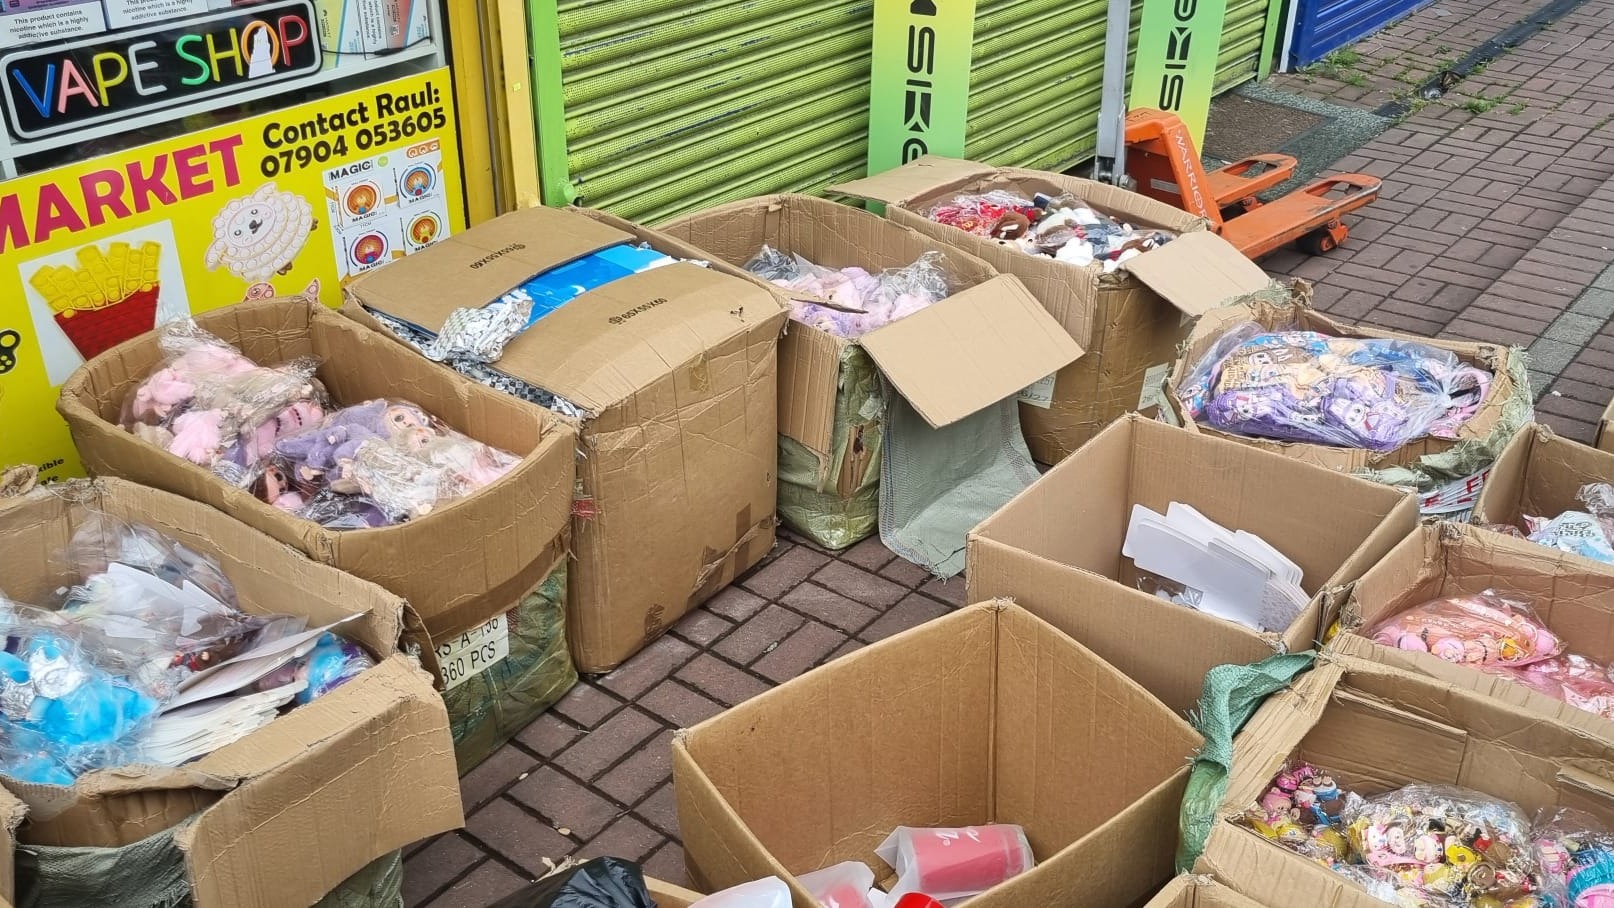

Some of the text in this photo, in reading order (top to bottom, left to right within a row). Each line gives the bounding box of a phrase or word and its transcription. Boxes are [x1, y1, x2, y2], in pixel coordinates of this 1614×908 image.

[9, 24, 36, 32] nicotine
[38, 21, 56, 29] which
[70, 15, 88, 25] highly
[30, 14, 54, 23] product
[56, 9, 82, 18] contains
[12, 41, 168, 118] VAPE
[175, 14, 308, 85] SHOP
[263, 101, 369, 150] Contact
[375, 81, 440, 117] Raul:
[260, 136, 348, 178] 07904
[355, 106, 447, 151] 053605
[330, 161, 371, 180] MAGIC
[441, 640, 496, 685] 360 PCS
